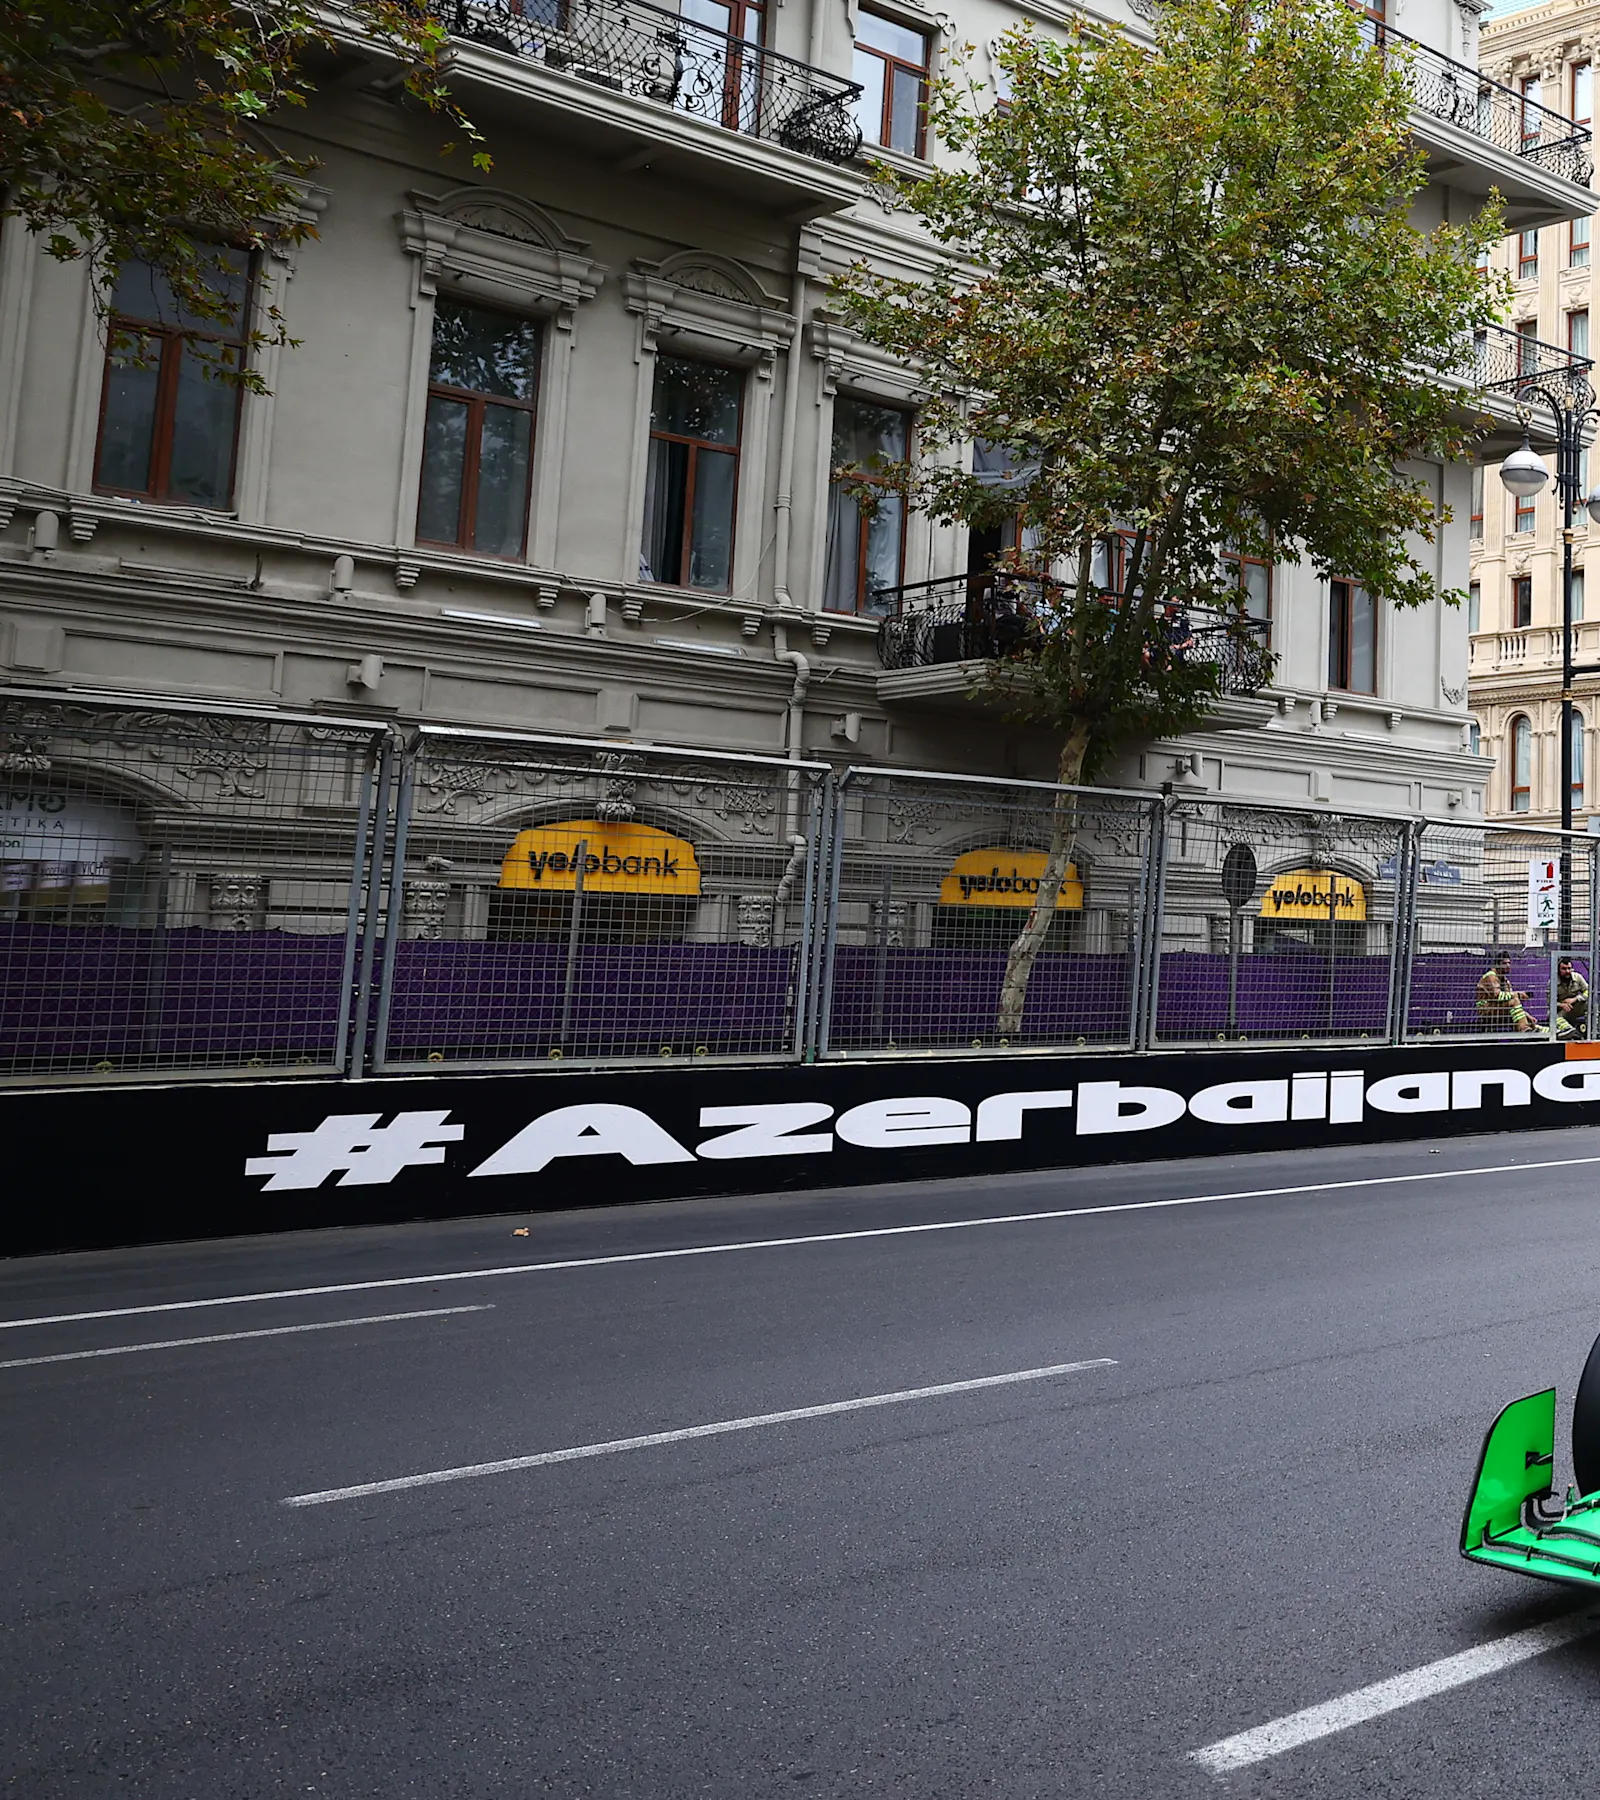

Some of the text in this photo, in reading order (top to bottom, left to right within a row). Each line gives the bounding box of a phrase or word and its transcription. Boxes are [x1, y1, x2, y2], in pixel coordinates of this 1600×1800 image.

[528, 843, 679, 881] yelobank
[959, 867, 1067, 899] yeloba
[1272, 884, 1355, 912] yelobank
